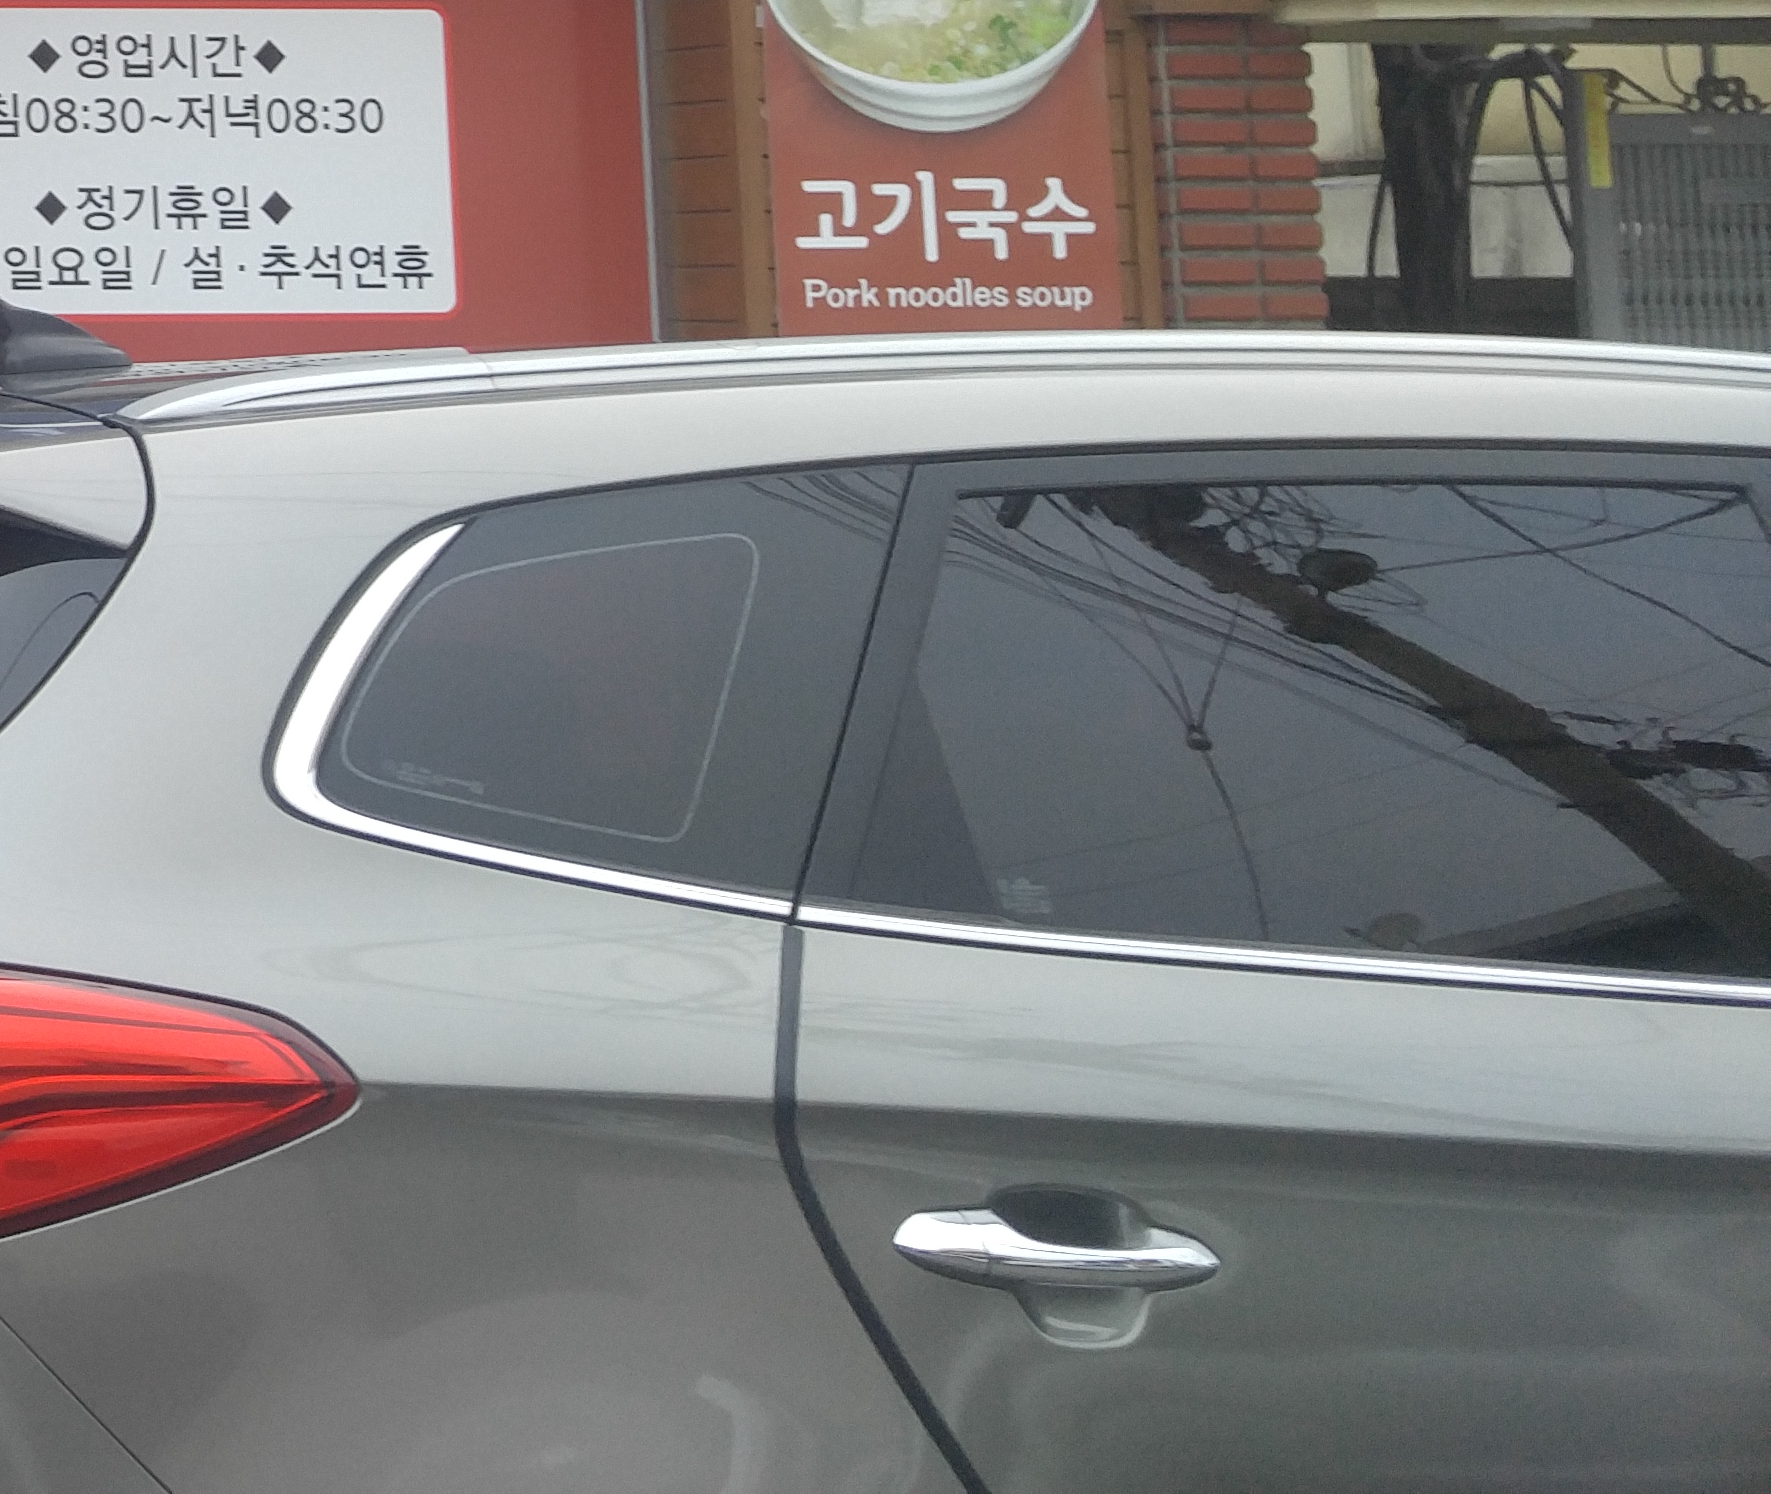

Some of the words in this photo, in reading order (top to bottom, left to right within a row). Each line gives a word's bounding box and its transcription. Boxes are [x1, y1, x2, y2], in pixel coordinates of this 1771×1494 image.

[70, 32, 247, 80] 영업시간
[75, 184, 251, 232] 정기휴일
[794, 170, 1097, 263] 고기국수
[3, 244, 134, 292] 일요일
[802, 278, 881, 309] Pork
[886, 277, 1011, 309] noodles
[1014, 285, 1095, 312] soup
